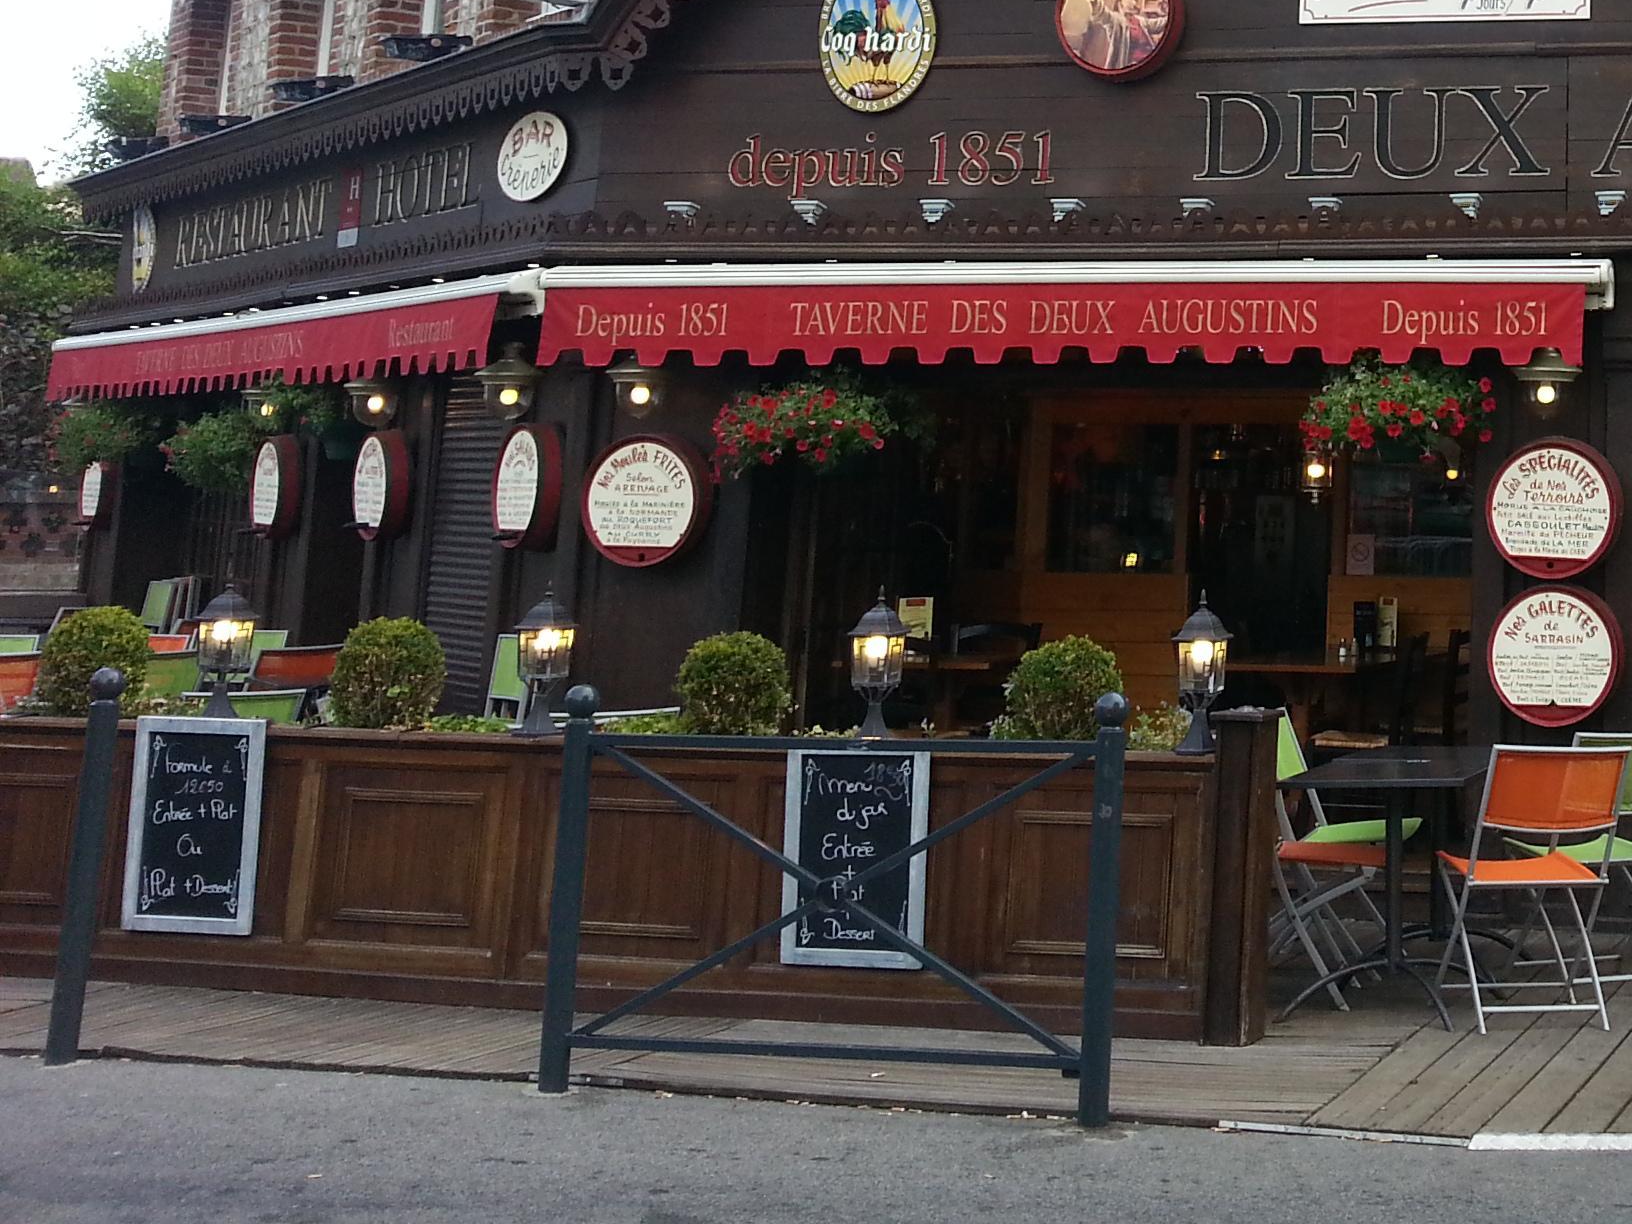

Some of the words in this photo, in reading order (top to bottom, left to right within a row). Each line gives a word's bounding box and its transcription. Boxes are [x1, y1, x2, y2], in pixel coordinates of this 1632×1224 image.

[821, 24, 857, 57] Coq
[864, 24, 931, 53] hardi
[856, 101, 878, 111] DES
[884, 59, 930, 108] FLANDRES
[511, 119, 555, 158] BAR
[1196, 86, 1554, 182] DEUX
[728, 132, 905, 200] depuis
[926, 130, 1055, 186] 1851
[173, 177, 333, 270] RESTAURANT
[371, 141, 482, 228] HOTEL
[388, 316, 455, 348] Restaurant
[574, 301, 666, 345] Depuis
[677, 302, 729, 337] 1851
[789, 300, 929, 337] TAVERNE
[949, 299, 1008, 335] DES
[1028, 299, 1116, 335] DEUX
[1138, 299, 1320, 336] AUGUSTINS
[1381, 299, 1480, 344] Depuis
[1494, 299, 1549, 335] 1851
[1502, 477, 1522, 500] Les
[1523, 489, 1585, 505] Terroirs
[1530, 479, 1541, 490] de
[1547, 479, 1568, 492] Nos
[1507, 520, 1581, 531] CASSOULET
[1504, 615, 1527, 642] Nos
[1527, 599, 1599, 639] GALETTES
[1543, 620, 1559, 632] de
[1524, 632, 1584, 644] SARRASIN
[153, 799, 194, 825] Entrée
[210, 798, 238, 821] Plat
[176, 833, 203, 857] Ou
[821, 832, 877, 861] Entrée
[149, 867, 176, 898] Plat
